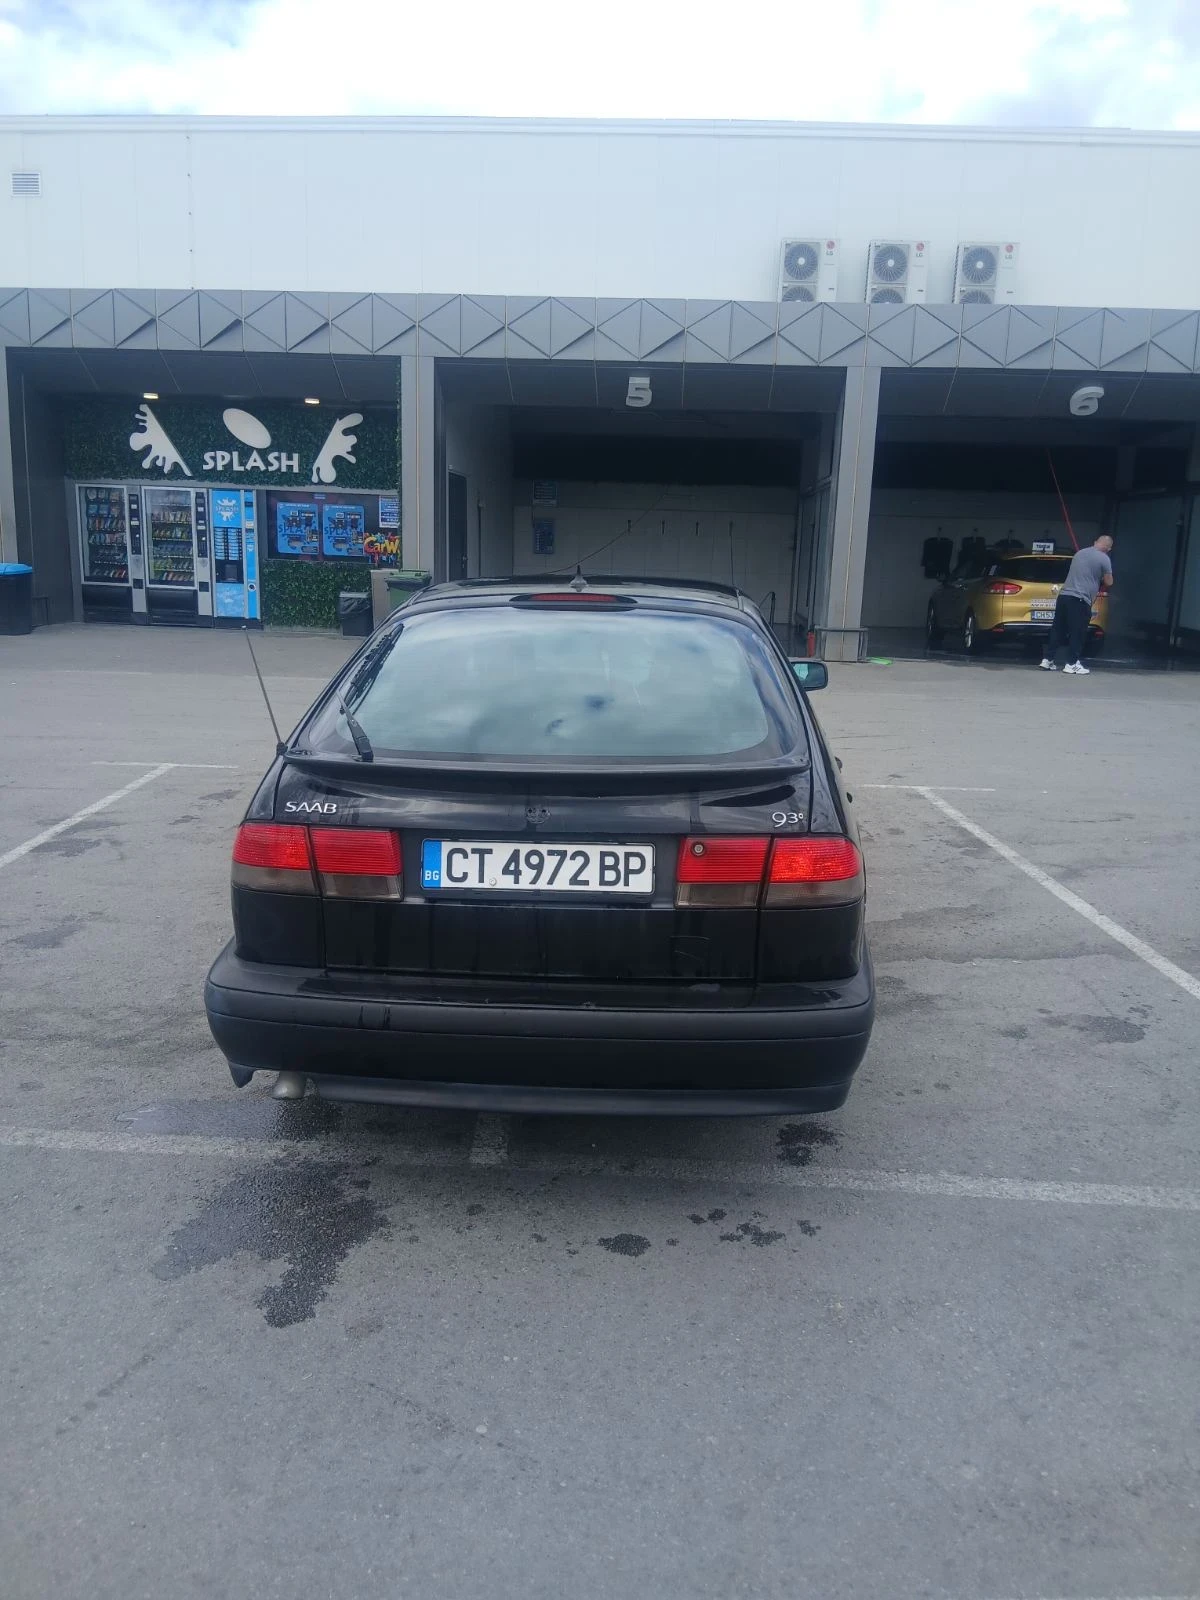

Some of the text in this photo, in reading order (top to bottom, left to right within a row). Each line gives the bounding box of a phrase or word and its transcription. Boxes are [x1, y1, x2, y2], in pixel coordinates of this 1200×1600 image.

[626, 376, 652, 407] 5
[1070, 386, 1104, 415] 6
[202, 450, 299, 473] SPLASH
[364, 536, 400, 554] CarW
[284, 801, 337, 814] SAAB
[424, 870, 439, 881] BG
[446, 847, 647, 887] CT 4972 BP
